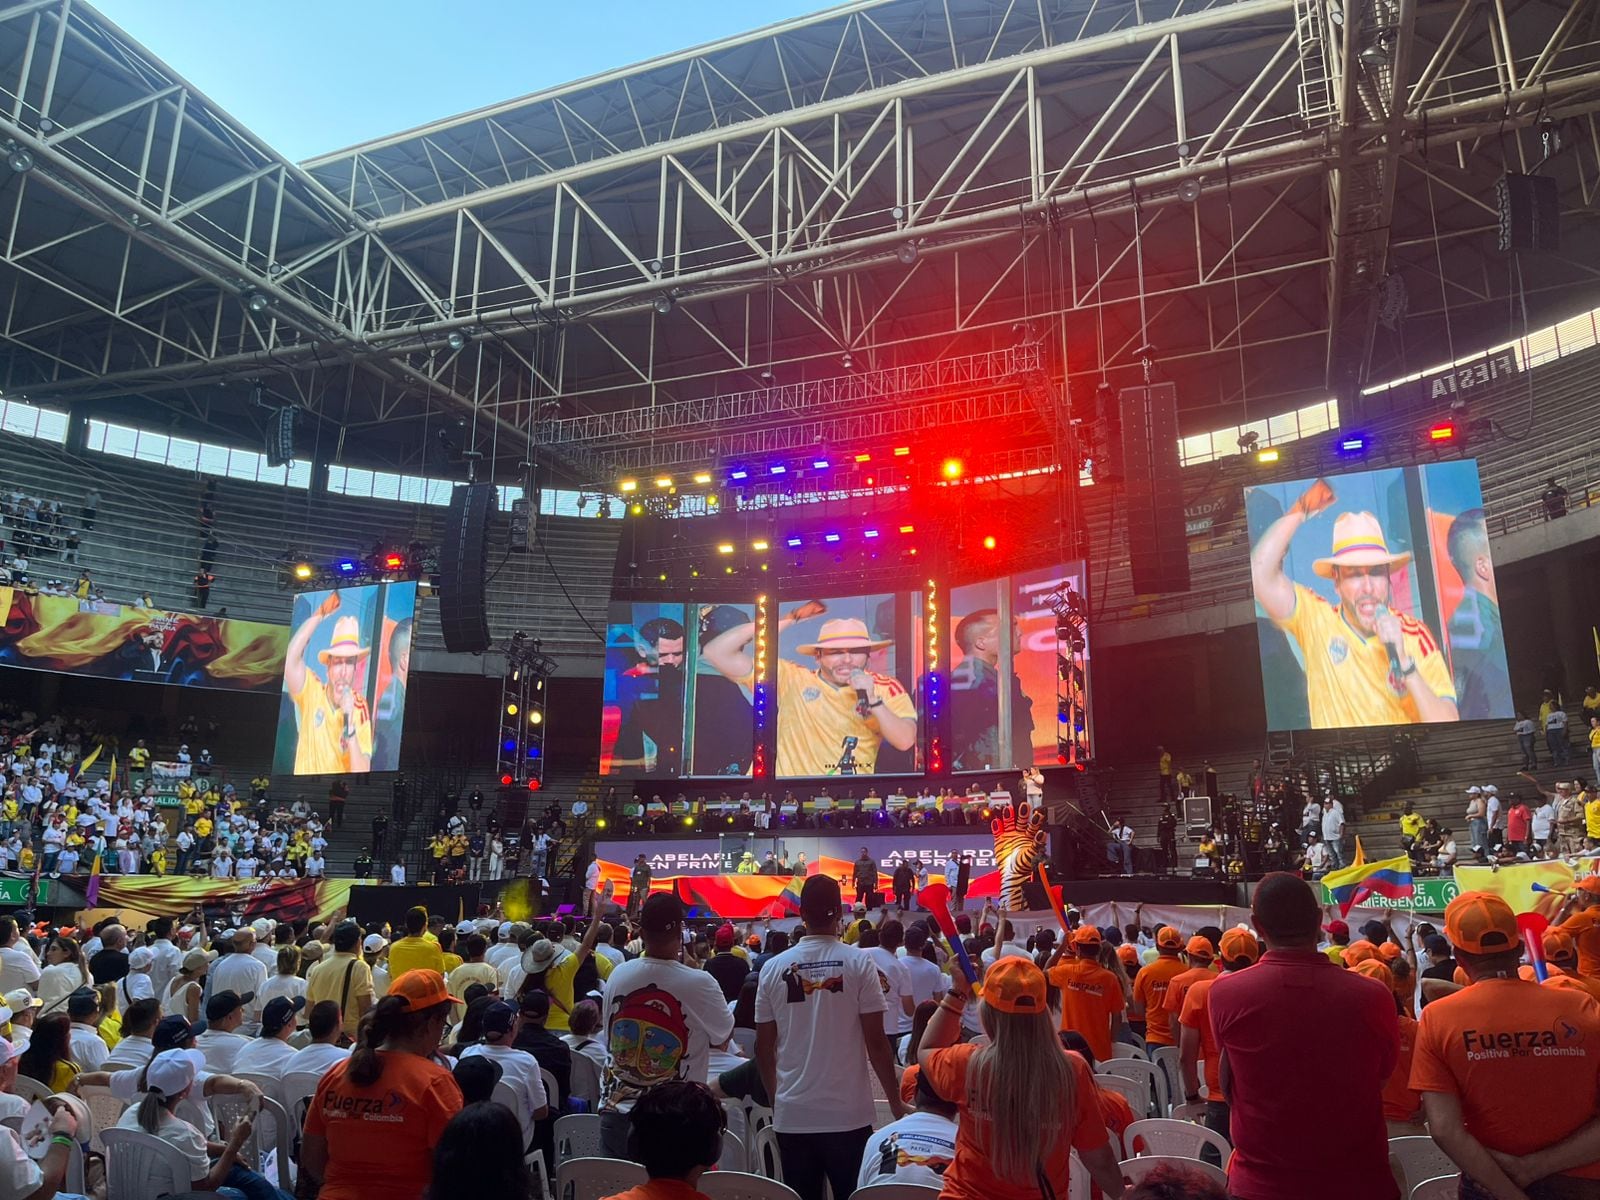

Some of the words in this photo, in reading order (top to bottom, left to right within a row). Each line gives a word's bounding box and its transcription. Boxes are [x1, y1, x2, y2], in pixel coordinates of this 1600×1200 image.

[677, 861, 733, 869] PRIME
[1447, 886, 1457, 900] 3
[1361, 896, 1436, 907] MERGENCIA
[1463, 1030, 1557, 1051] Fuerza
[1467, 1049, 1509, 1060] Positiva
[1533, 1046, 1586, 1057] Colombia
[323, 1090, 383, 1113] Fuerza
[363, 1112, 404, 1122] Colombia
